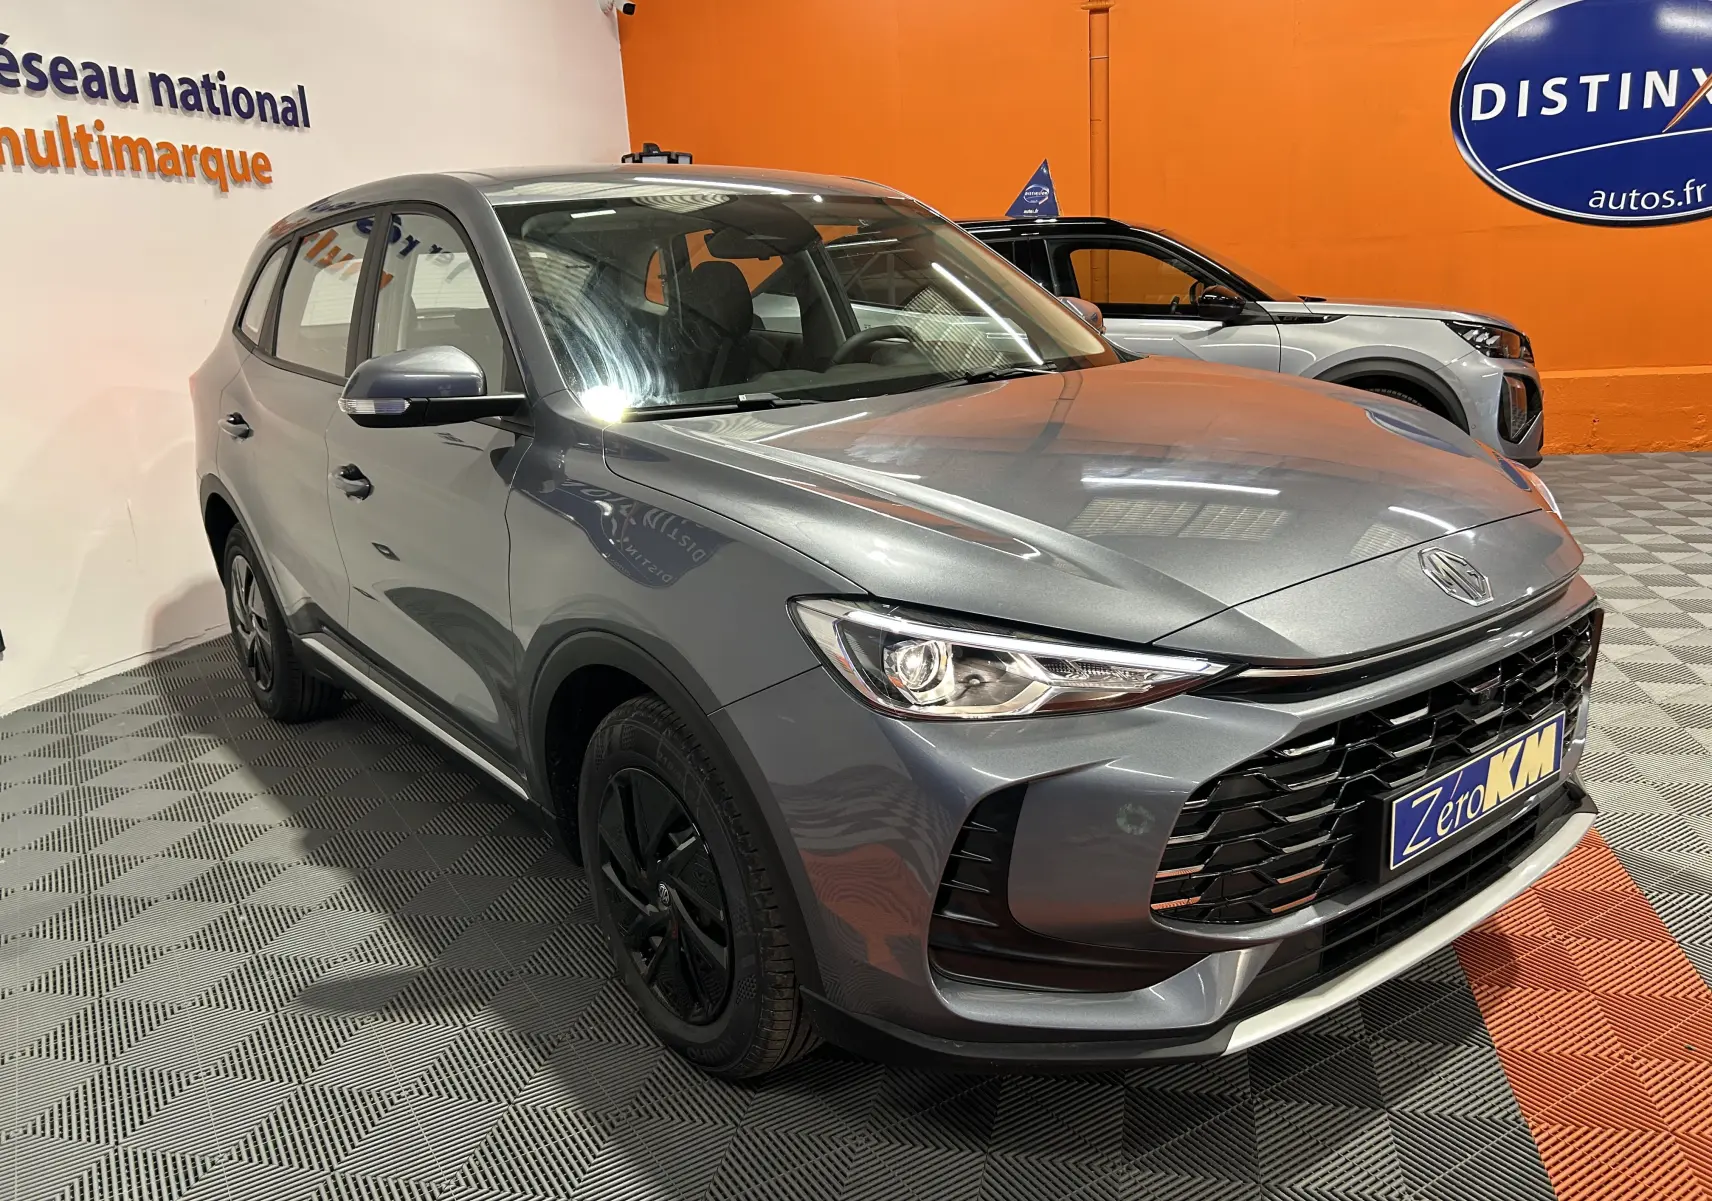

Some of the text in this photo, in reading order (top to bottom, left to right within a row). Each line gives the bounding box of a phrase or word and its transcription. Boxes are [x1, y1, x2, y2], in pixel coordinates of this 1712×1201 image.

[149, 70, 310, 128] national
[1588, 179, 1707, 210] autos.fr
[1421, 549, 1490, 604] MG
